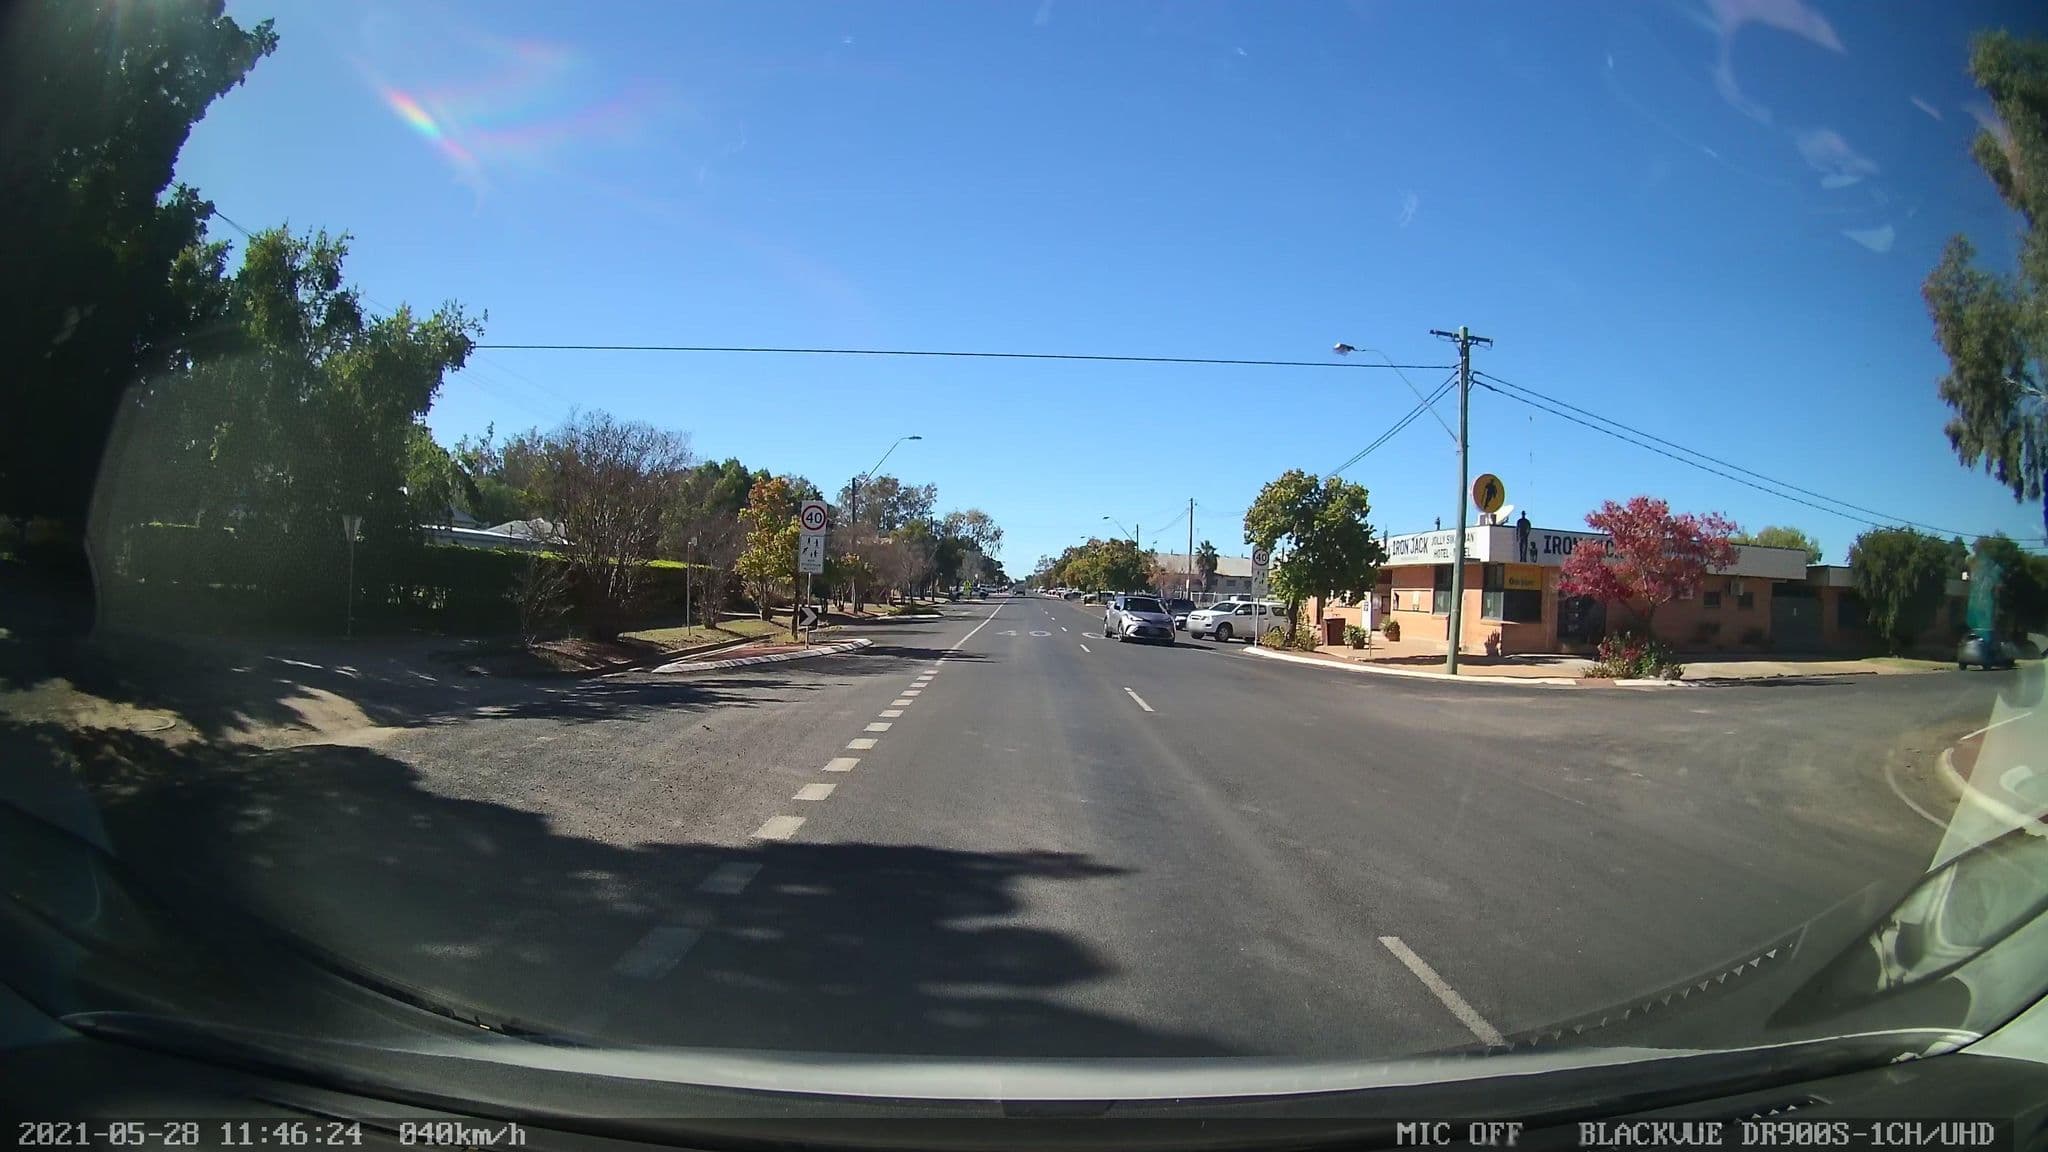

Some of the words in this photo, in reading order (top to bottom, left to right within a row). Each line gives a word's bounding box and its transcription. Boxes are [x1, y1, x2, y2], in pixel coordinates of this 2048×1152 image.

[806, 512, 822, 523] 40
[1392, 539, 1409, 556] IRON
[1410, 536, 1428, 554] JACK
[1255, 553, 1267, 563] 40
[1433, 548, 1449, 559] HOTEL
